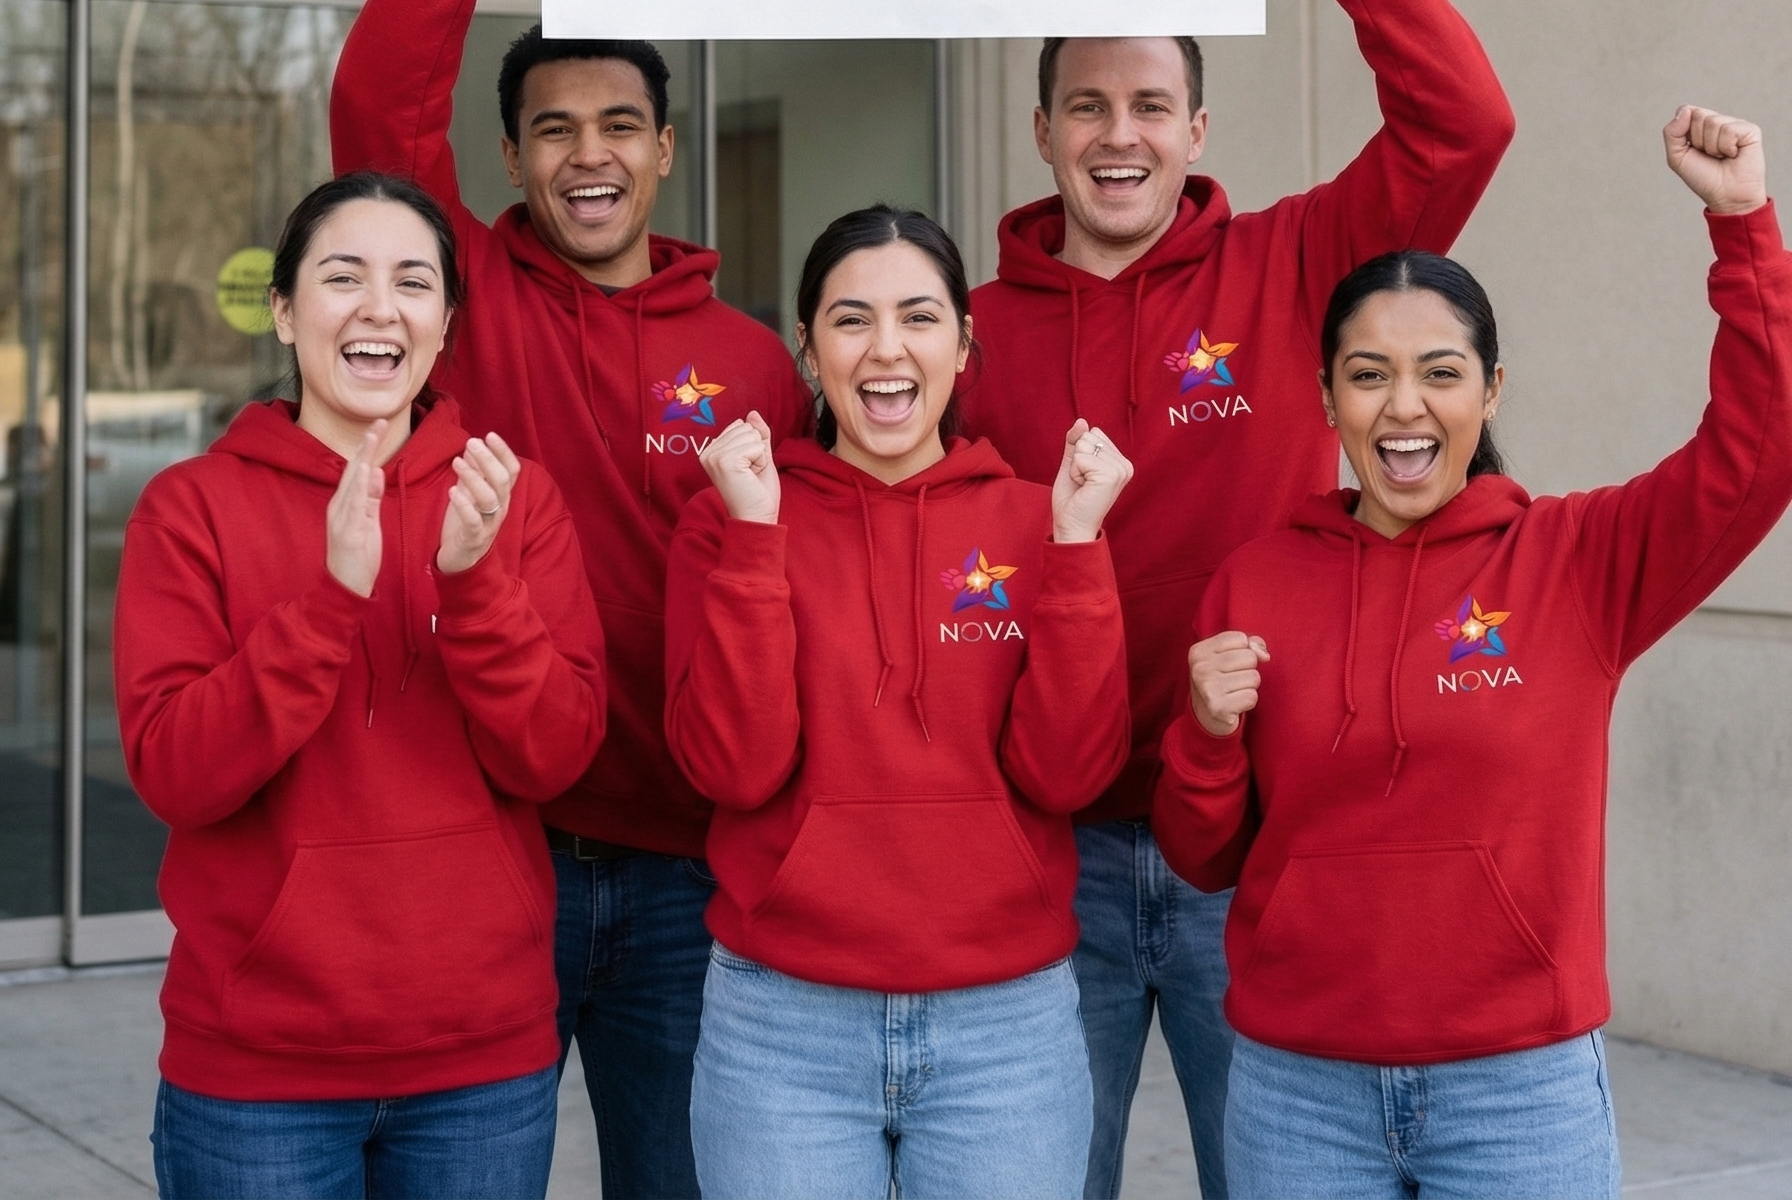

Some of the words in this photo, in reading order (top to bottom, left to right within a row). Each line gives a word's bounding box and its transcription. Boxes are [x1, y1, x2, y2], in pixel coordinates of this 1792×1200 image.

[1168, 394, 1253, 427] NOVA
[645, 433, 710, 456] NOV
[939, 620, 1024, 643] NOVA
[1437, 666, 1523, 694] NOVA
